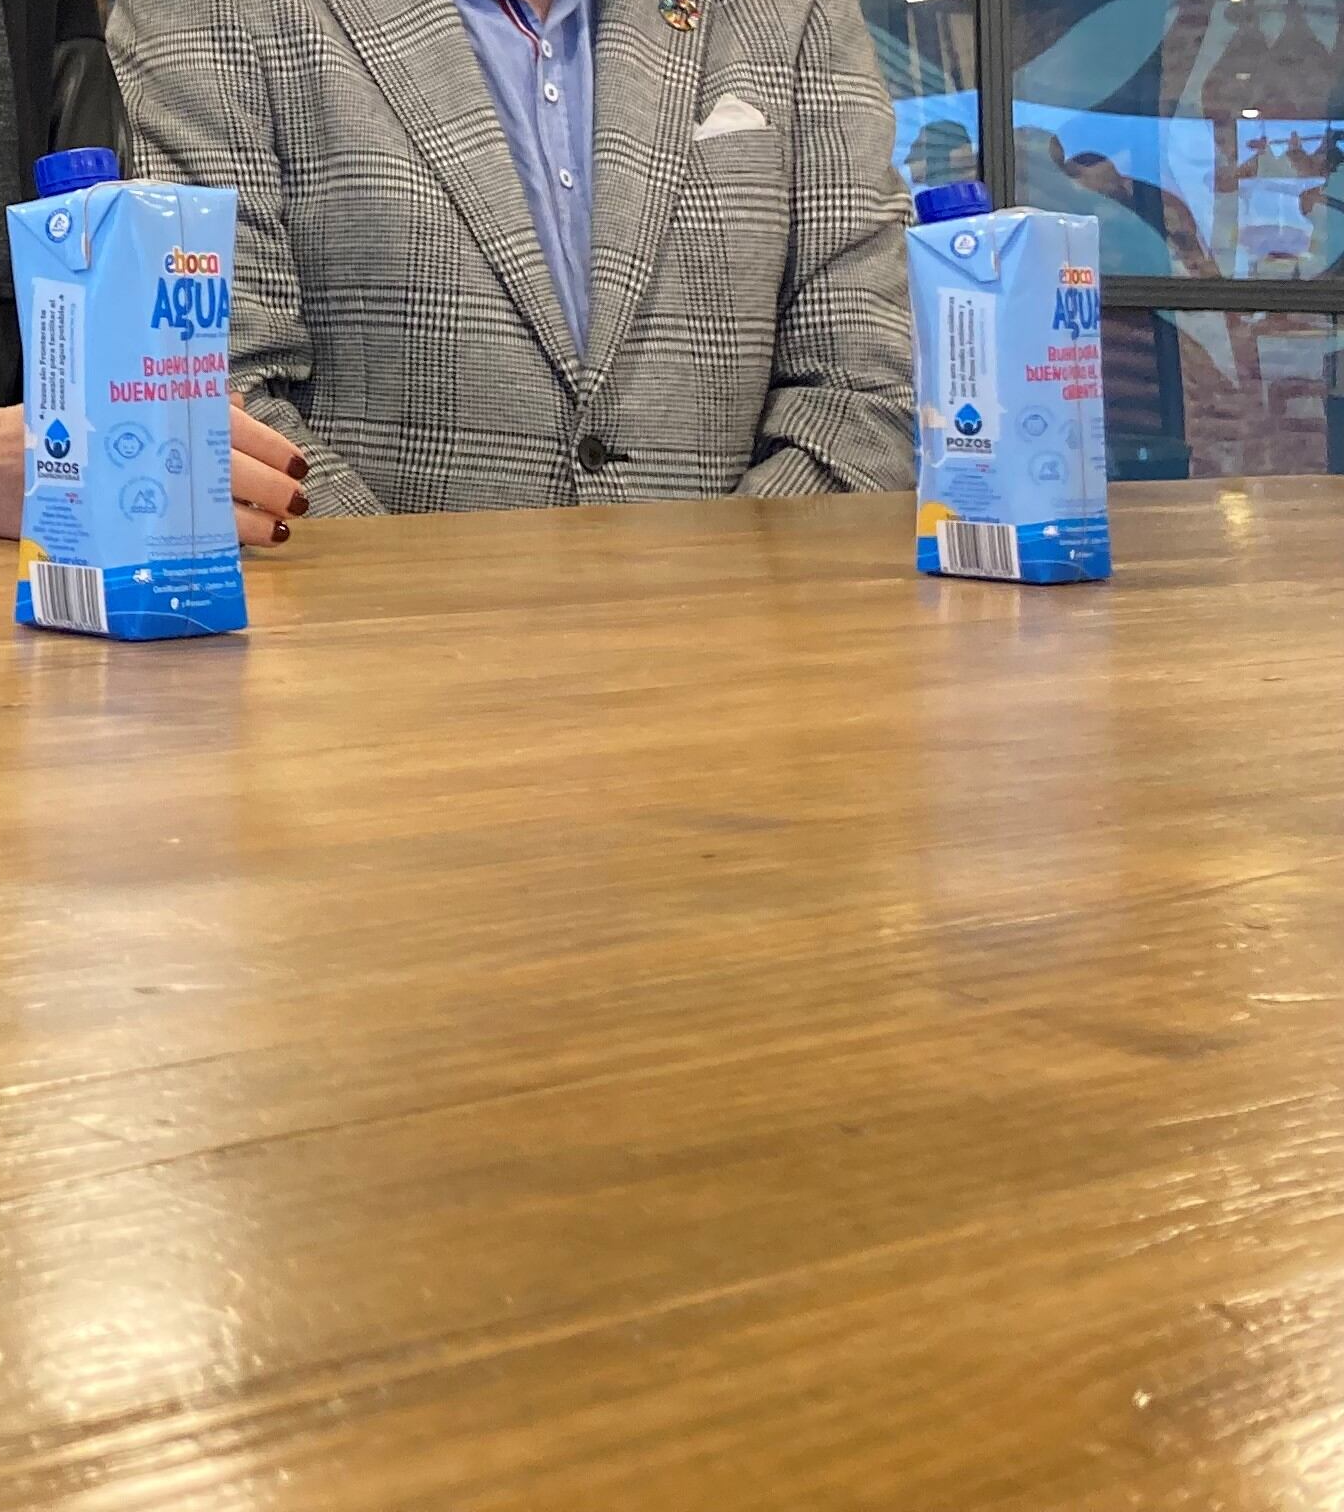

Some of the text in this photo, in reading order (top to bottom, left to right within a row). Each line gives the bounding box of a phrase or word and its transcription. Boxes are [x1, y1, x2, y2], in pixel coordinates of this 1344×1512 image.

[164, 248, 220, 275] eboca
[946, 437, 992, 449] POZOS
[37, 460, 79, 474] POZOS
